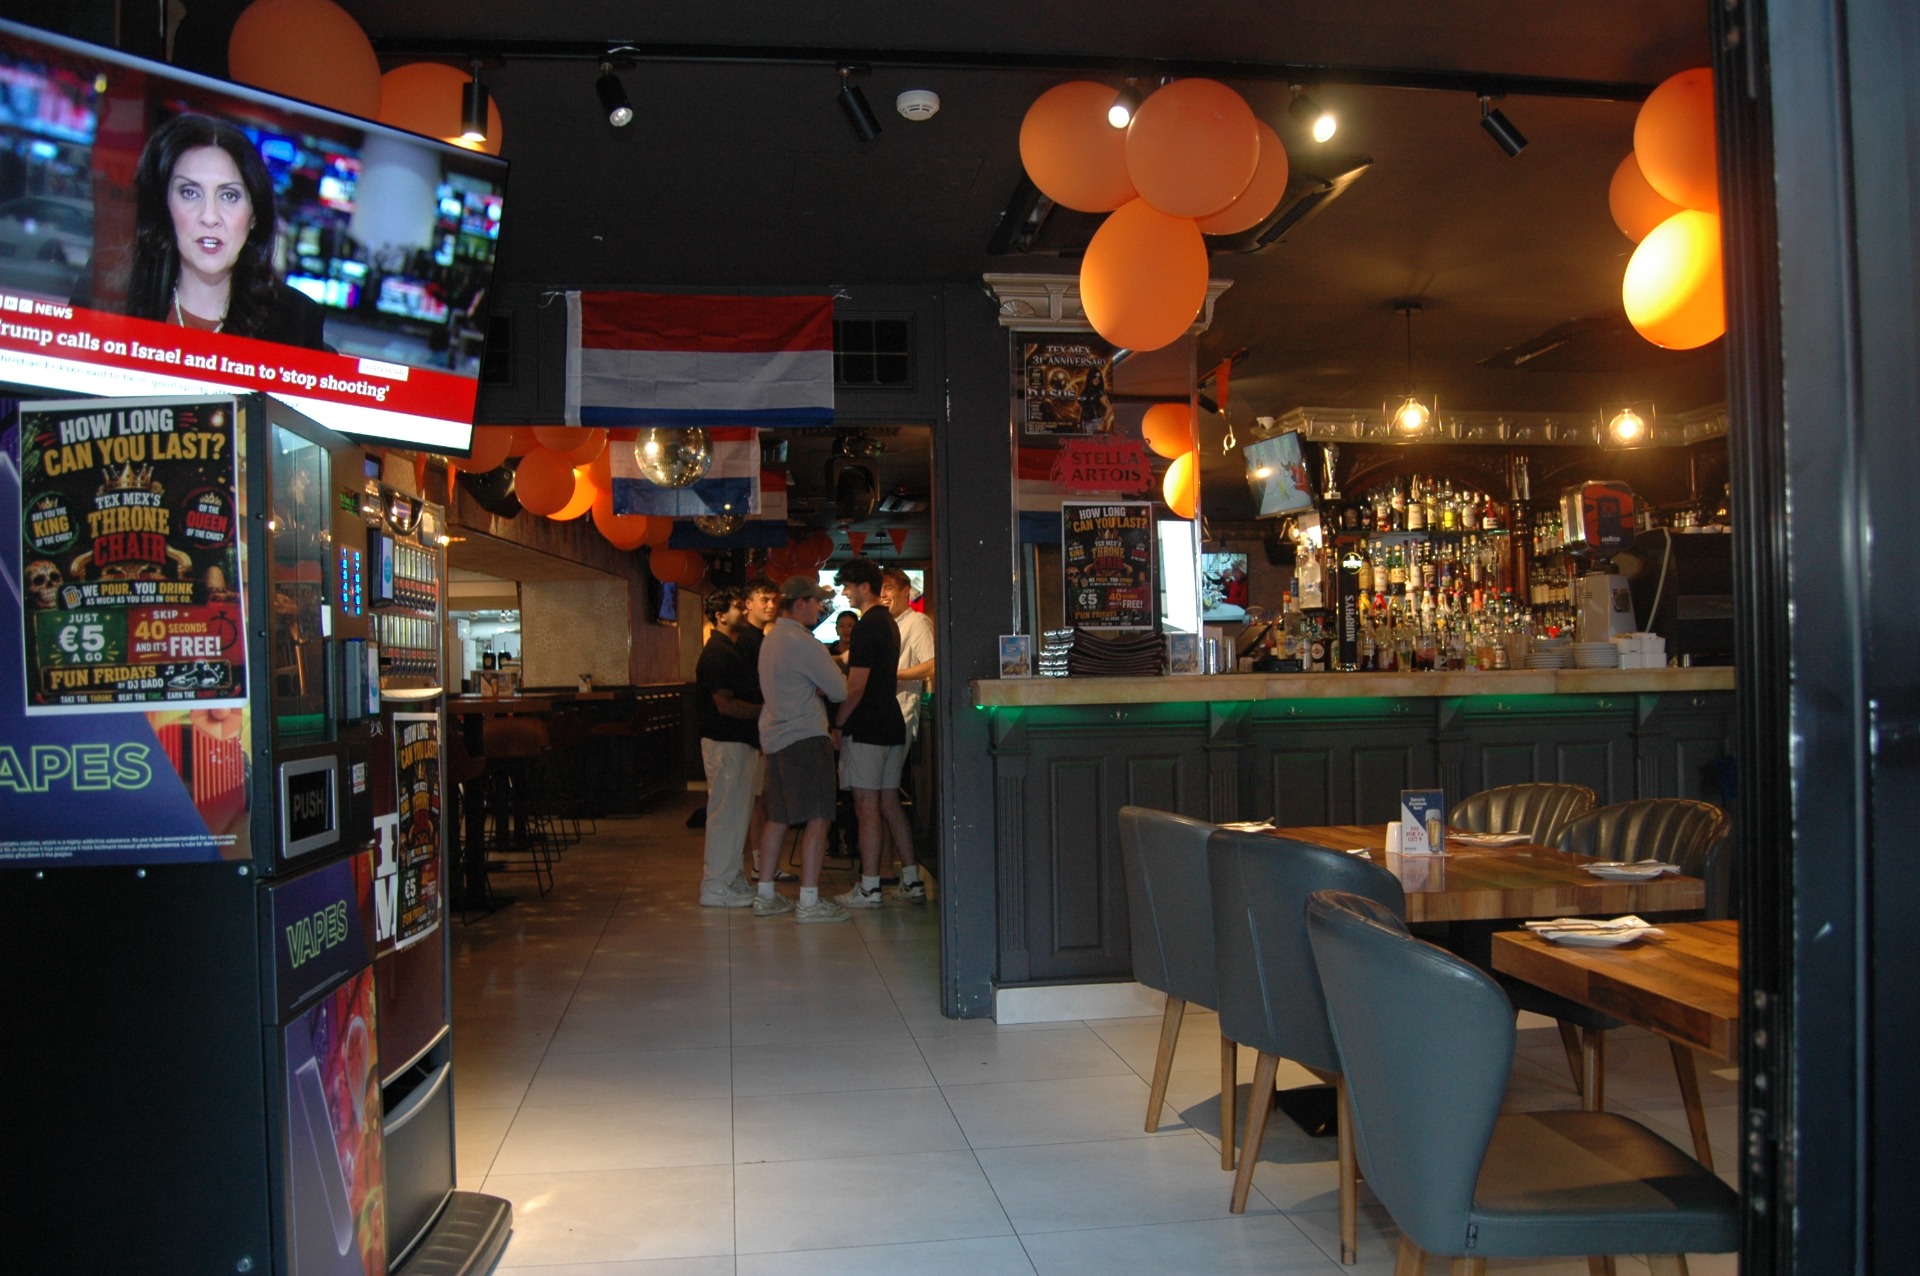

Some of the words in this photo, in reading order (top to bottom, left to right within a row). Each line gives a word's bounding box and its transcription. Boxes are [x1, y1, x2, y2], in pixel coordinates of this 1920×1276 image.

[35, 302, 73, 319] NEWS
[56, 332, 100, 351] calls
[103, 340, 127, 356] on
[131, 341, 181, 365] Israel
[184, 354, 217, 371] and
[220, 357, 255, 376] Iran
[258, 364, 276, 380] to
[279, 366, 317, 389] 'stop
[319, 374, 390, 402] shooting'
[1049, 357, 1107, 366] ANNIVERSARY
[60, 413, 112, 445] HOW
[118, 409, 174, 435] LONG
[44, 442, 93, 477] CAN
[97, 435, 145, 466] YOU
[152, 433, 226, 460] LAST?
[1072, 452, 1140, 465] STELLA
[1072, 468, 1141, 481] ARTOIS
[95, 493, 119, 510] TEX
[124, 492, 161, 507] MEX'S
[33, 511, 43, 521] ARE
[44, 509, 55, 519] YOU
[56, 507, 67, 516] THE
[199, 504, 208, 513] OR
[209, 504, 219, 515] THE
[1079, 508, 1100, 520] HOW
[1103, 507, 1126, 517] LONG
[33, 515, 70, 538] KING
[88, 509, 170, 539] THRONE
[186, 510, 228, 532] QUEEN
[1073, 521, 1094, 532] CAN
[1096, 518, 1118, 529] YOU
[1119, 517, 1147, 528] LAST?
[43, 536, 54, 546] THE
[195, 529, 206, 540] THE
[93, 532, 167, 567] CHAIR
[1069, 548, 1084, 557] KING
[1092, 547, 1125, 559] THRONE
[82, 584, 99, 597] WE
[135, 582, 156, 594] YOU
[159, 582, 193, 594] DRINK
[86, 597, 95, 605] AS
[115, 596, 125, 604] AS
[155, 595, 164, 603] IN
[1079, 594, 1098, 605] €5
[1123, 600, 1143, 608] FREE!
[69, 613, 99, 624] JUST
[153, 611, 179, 620] SKIP
[135, 620, 166, 640] 40
[168, 623, 207, 633] SECONDS
[59, 625, 105, 653] €5
[135, 642, 152, 652] AND
[152, 641, 167, 652] IT'S
[170, 636, 221, 657] FREE!
[72, 653, 80, 663] A
[85, 652, 102, 662] GO
[50, 669, 90, 690] FUN
[94, 665, 157, 683] FRIDAYS
[127, 680, 139, 689] DJ
[140, 678, 164, 689] DADO
[61, 695, 75, 703] TAKE
[76, 694, 88, 703] THE
[118, 693, 133, 702] BEAT
[134, 693, 145, 701] THE
[167, 691, 182, 699] EARN
[183, 691, 195, 699] THE
[293, 788, 324, 823] PUSH
[286, 899, 347, 969] VAPES
